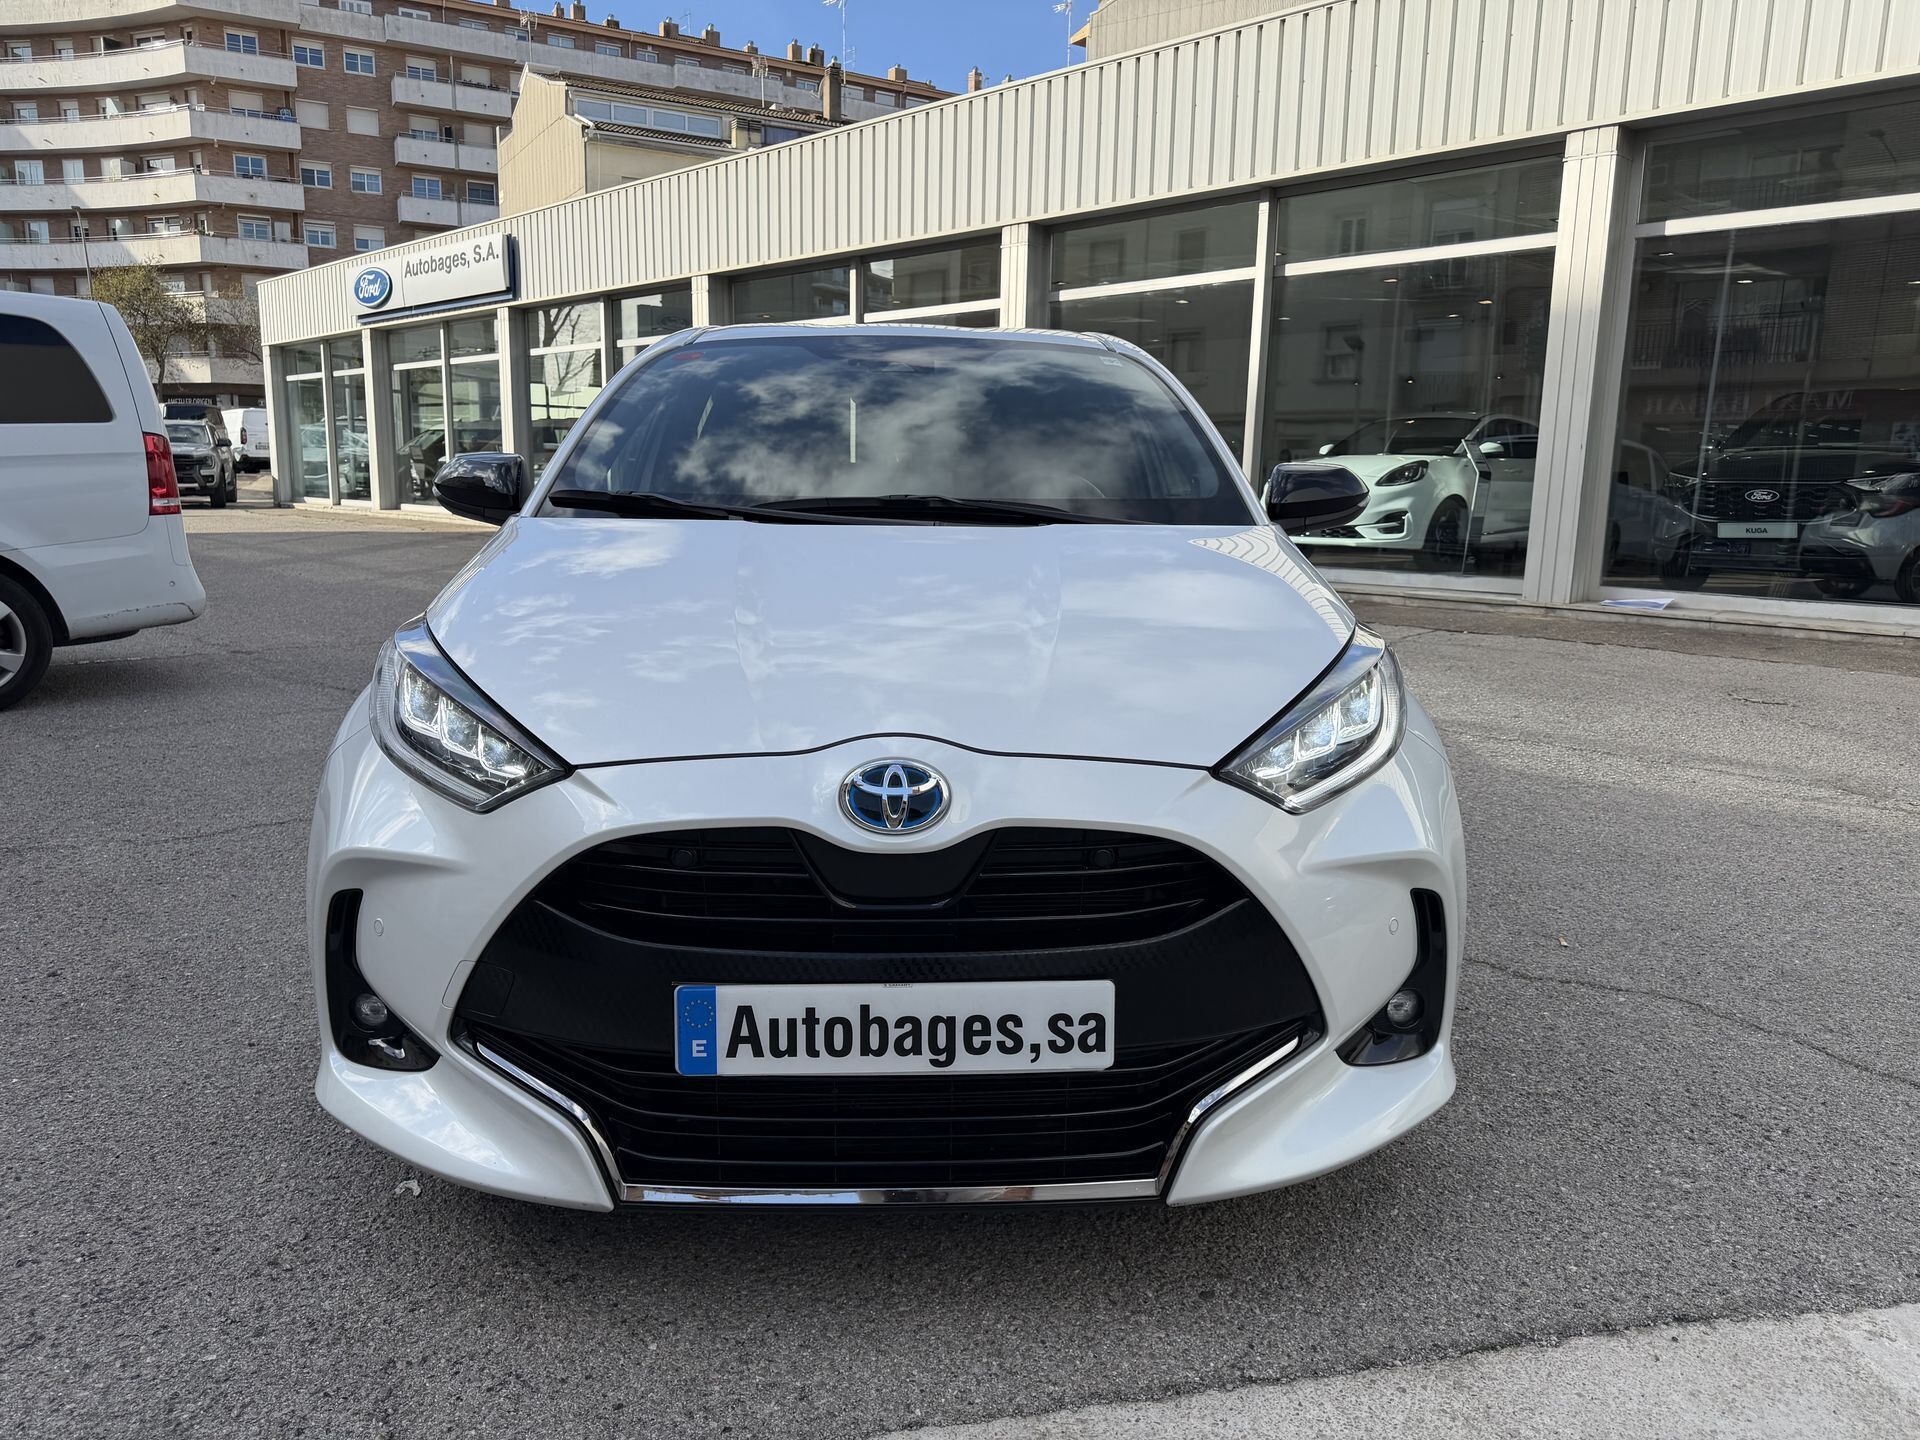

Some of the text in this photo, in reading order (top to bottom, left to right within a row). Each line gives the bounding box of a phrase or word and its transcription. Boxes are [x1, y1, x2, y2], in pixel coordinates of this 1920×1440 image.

[404, 241, 500, 279] Autobages, S.A.
[358, 274, 381, 300] Ford
[1750, 490, 1774, 501] Ford
[692, 1040, 707, 1057] E
[725, 1004, 1107, 1068] Autobages,sa
